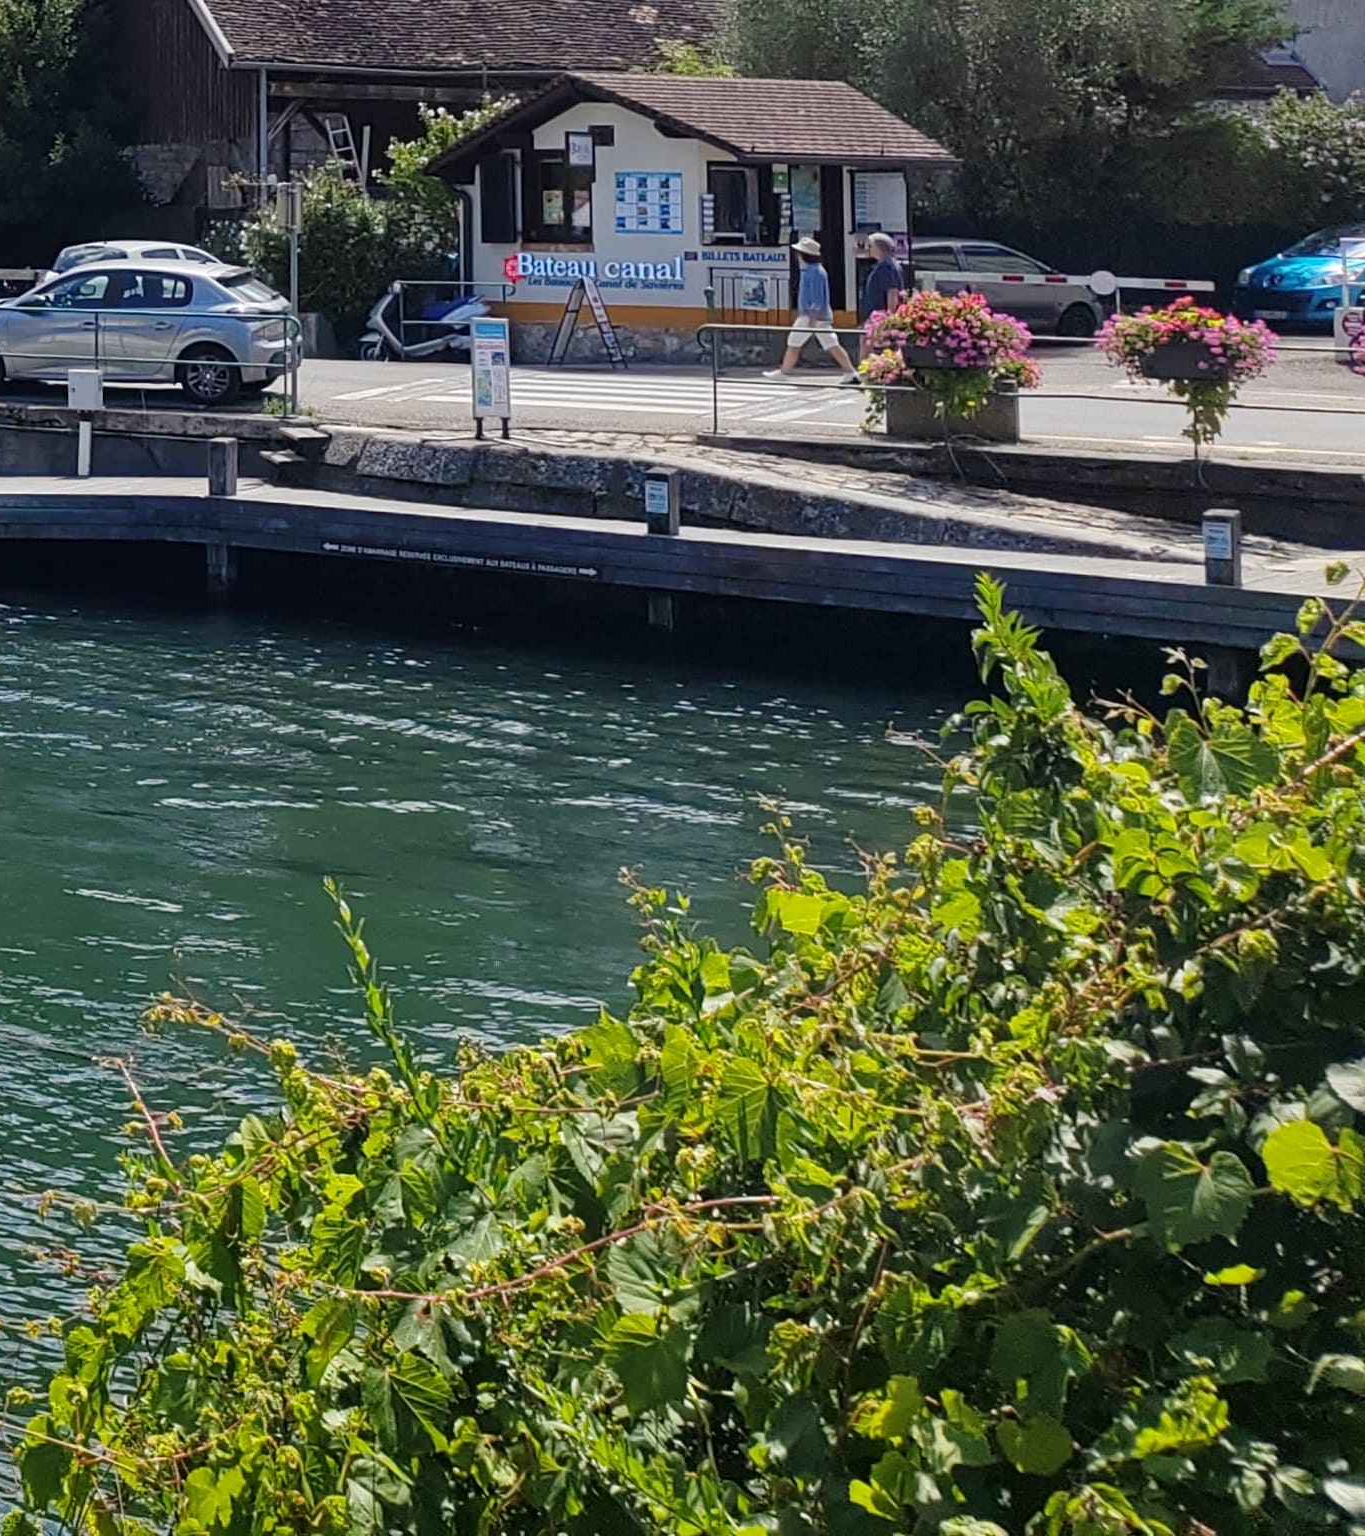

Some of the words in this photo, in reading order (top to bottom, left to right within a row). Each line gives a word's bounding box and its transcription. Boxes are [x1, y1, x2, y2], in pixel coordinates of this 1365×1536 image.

[516, 252, 597, 277] Bateau
[604, 255, 685, 281] canal
[701, 251, 740, 262] BILLETS
[743, 252, 788, 263] BATEAUX
[485, 557, 500, 567] AUX
[500, 559, 531, 570] BATEAUX
[537, 563, 578, 576] PASSAGERS
